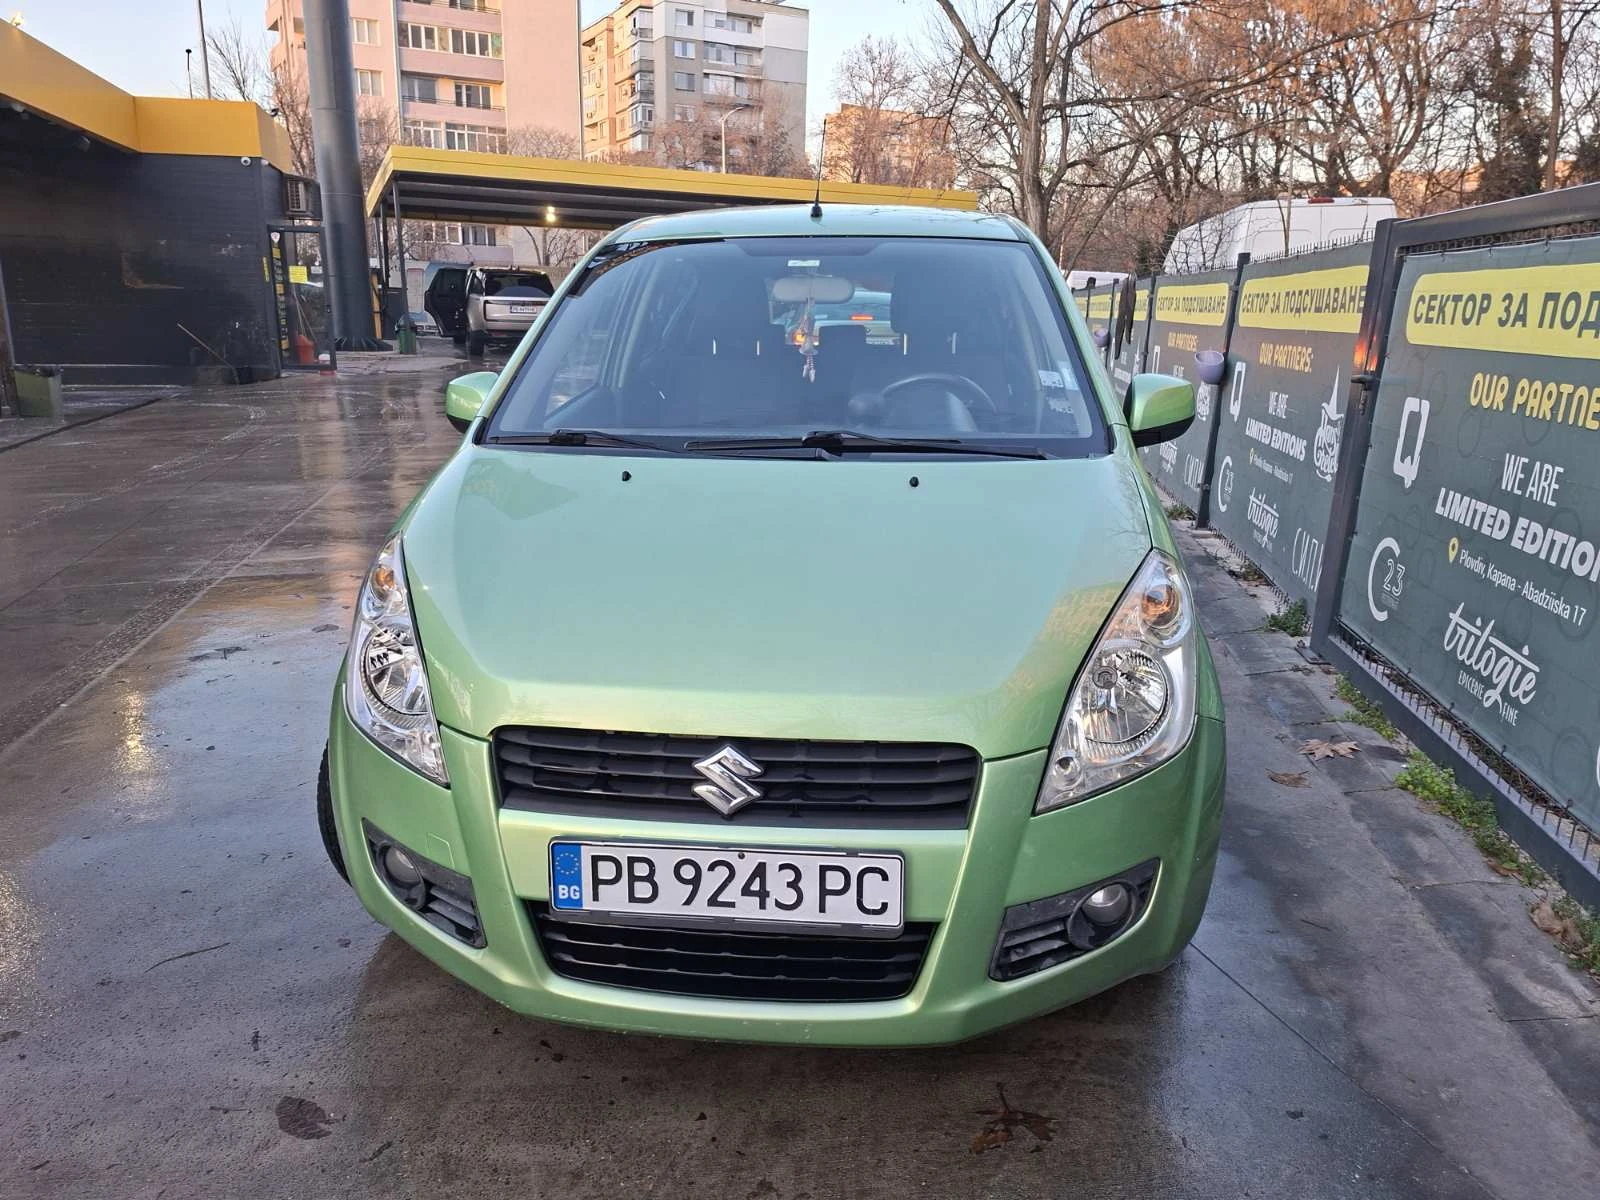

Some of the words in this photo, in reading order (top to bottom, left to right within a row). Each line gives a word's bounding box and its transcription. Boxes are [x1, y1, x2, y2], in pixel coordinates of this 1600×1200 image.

[1242, 291, 1270, 313] СЕКТОР
[1270, 291, 1280, 314] ЗА
[1283, 285, 1367, 318] ПОДСУШАВАНЕ
[1413, 293, 1492, 326] СЕКТОР
[1497, 292, 1529, 328] ЗА
[1537, 291, 1600, 339] ПОД
[1259, 342, 1273, 367] OUR
[1273, 344, 1314, 373] PARTNERS:
[1269, 391, 1279, 415] WE
[1276, 392, 1289, 419] ARE
[1469, 372, 1509, 412] OUR
[1245, 417, 1272, 445] LIMITED
[1270, 428, 1307, 462] EDITIONS
[1501, 453, 1529, 496] WE
[1525, 461, 1565, 507] ARE
[1434, 487, 1511, 541] LIMITED
[1459, 549, 1486, 579] Plovdiv,
[1486, 562, 1517, 591] Kapana
[1521, 581, 1571, 620] Abadziiska
[1572, 605, 1587, 627] 17
[1443, 602, 1540, 711] trilogie
[1501, 702, 1519, 726] FINE
[557, 884, 581, 900] BG
[590, 854, 660, 905] PB
[673, 857, 805, 912] 9243
[817, 863, 890, 916] PC
